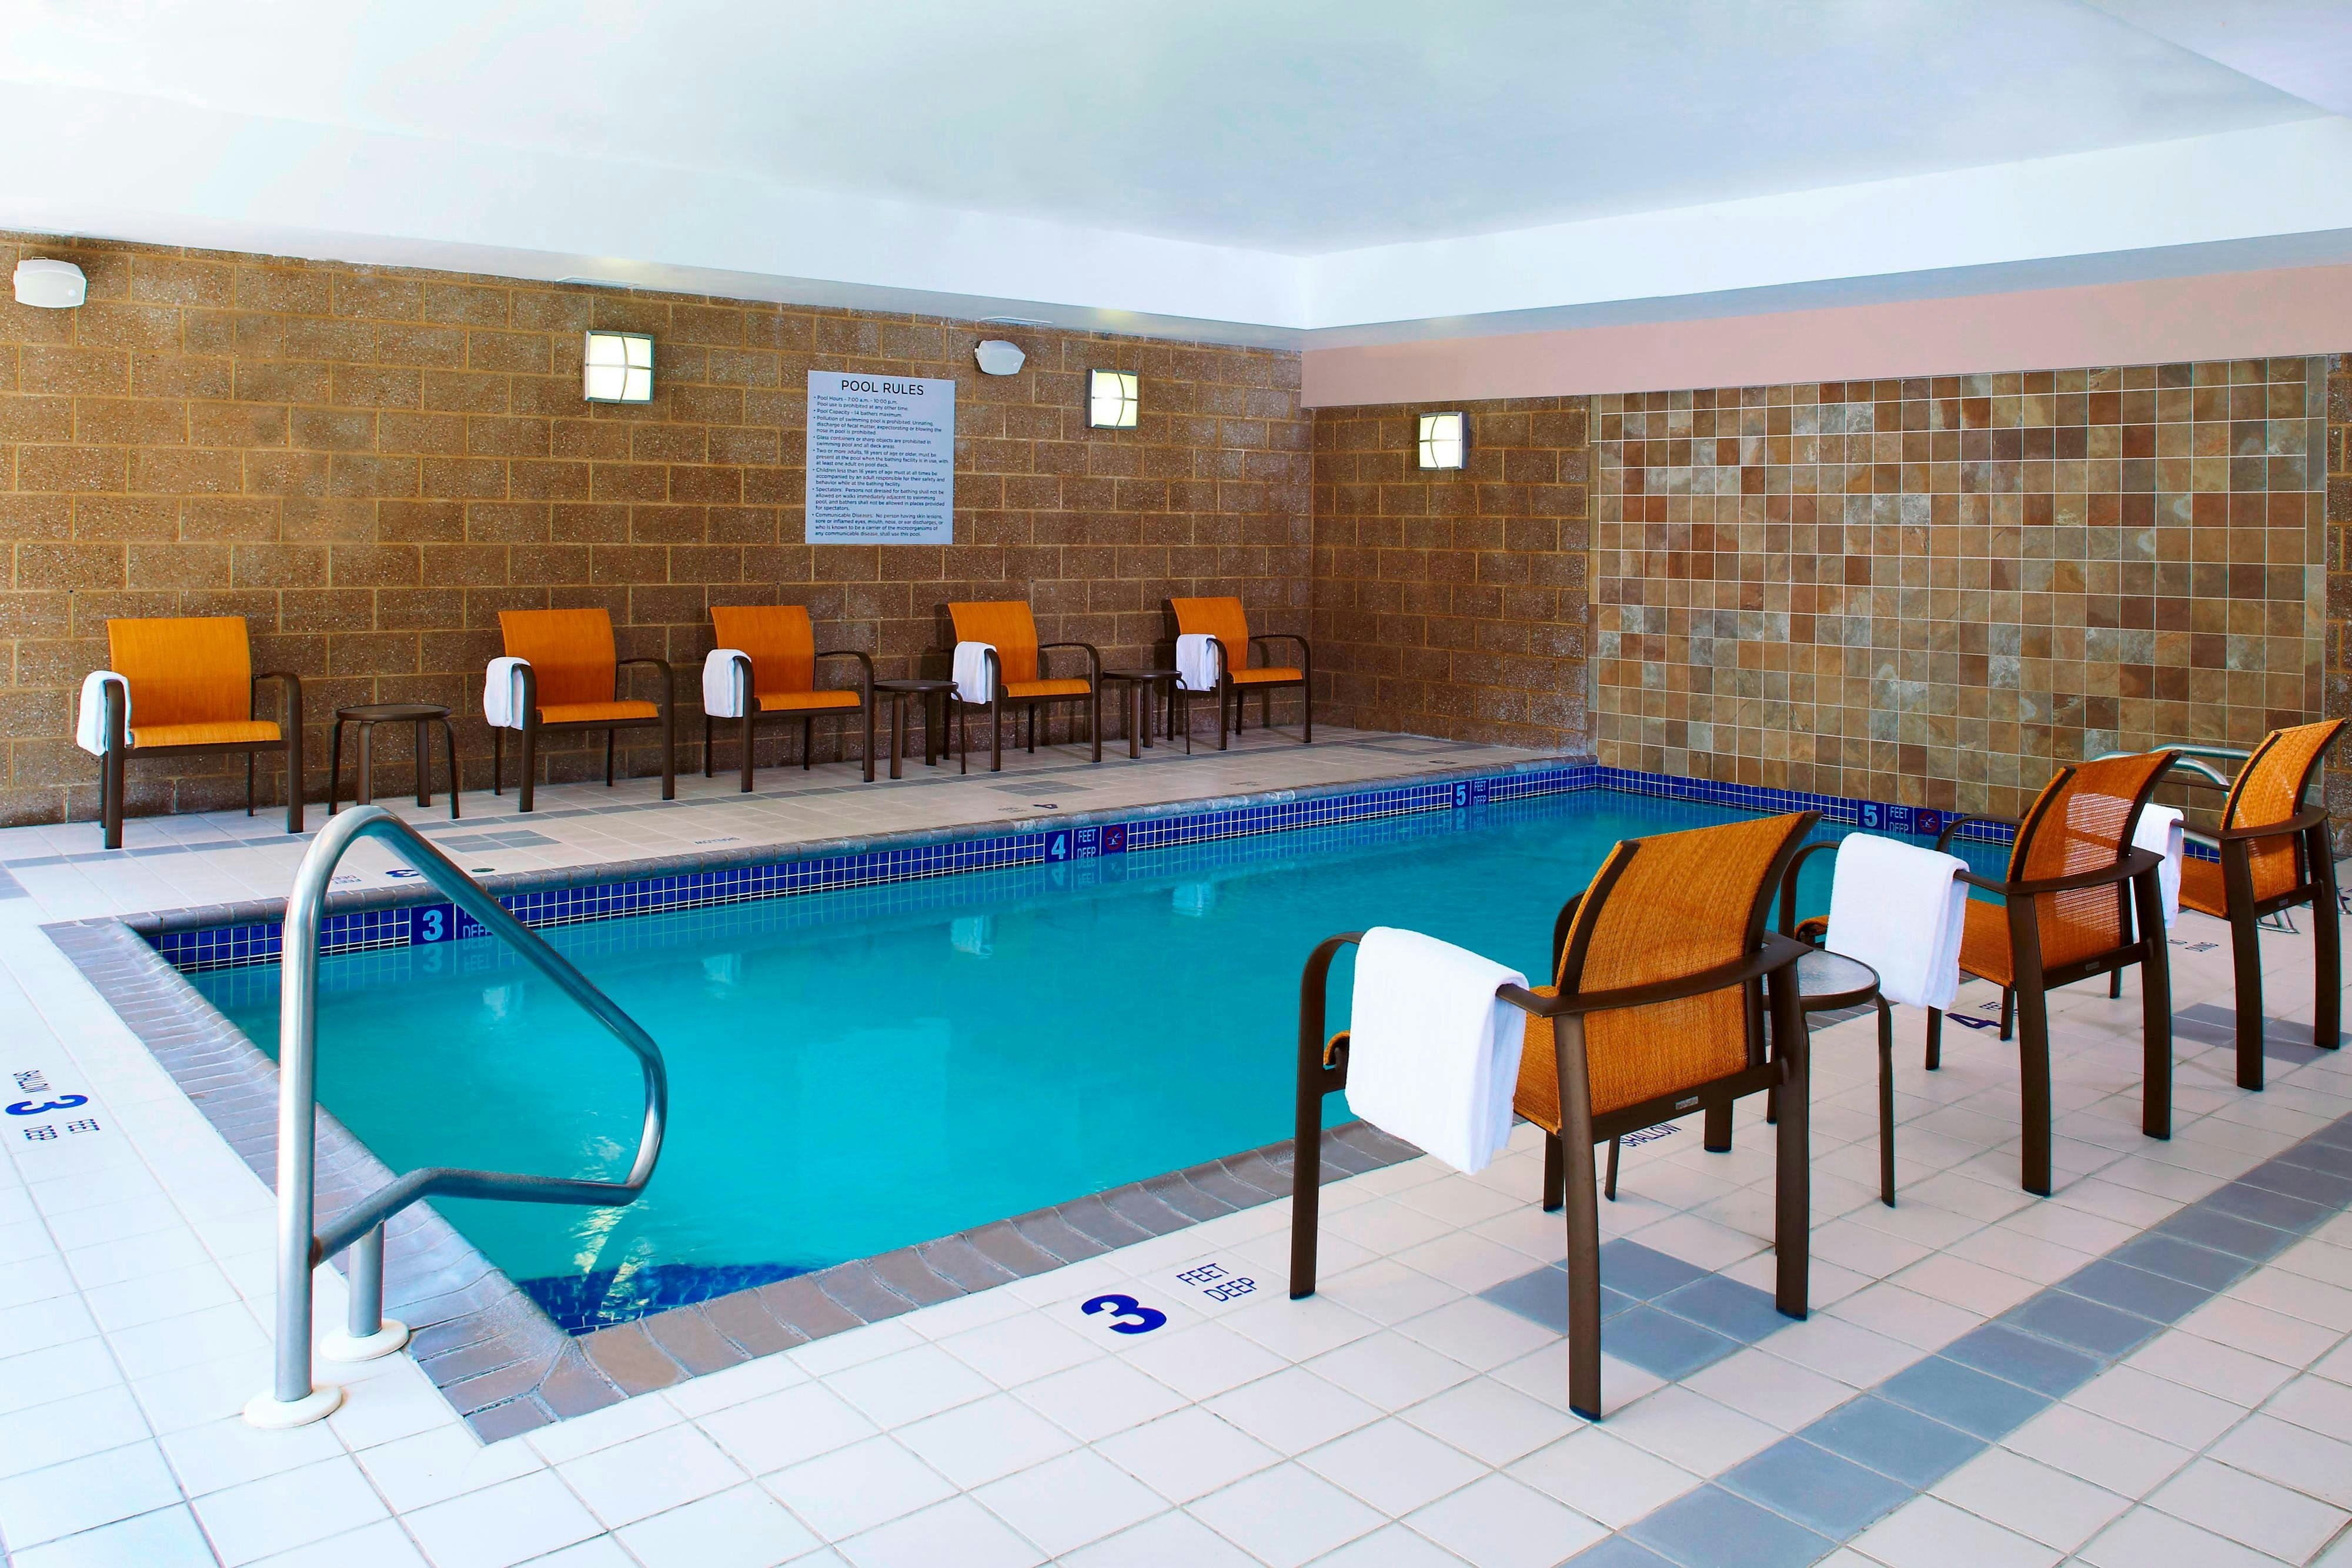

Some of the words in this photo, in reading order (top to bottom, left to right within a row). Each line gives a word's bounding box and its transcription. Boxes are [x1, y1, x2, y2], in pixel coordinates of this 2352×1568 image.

[842, 380, 878, 393] POOL
[883, 383, 924, 396] RULES
[1456, 785, 1466, 805] 5
[1474, 781, 1486, 792] FEET
[1864, 804, 1877, 827] 5
[1890, 806, 1908, 819] FEET
[1078, 829, 1096, 842] FEET
[1889, 822, 1909, 834] DEEP
[1051, 834, 1065, 860] 4
[1077, 846, 1096, 859] DEEP
[422, 910, 443, 941] 3
[1945, 1012, 2002, 1029] 4
[13, 1069, 52, 1094] SHALLOW
[5, 1094, 89, 1115] 3
[24, 1125, 58, 1141] DEEP
[66, 1118, 100, 1134] FEET
[1619, 1122, 1682, 1147] SHALLOW
[1176, 1262, 1230, 1286] FEET
[1202, 1277, 1257, 1302] DEEP
[1081, 1293, 1167, 1335] 3
